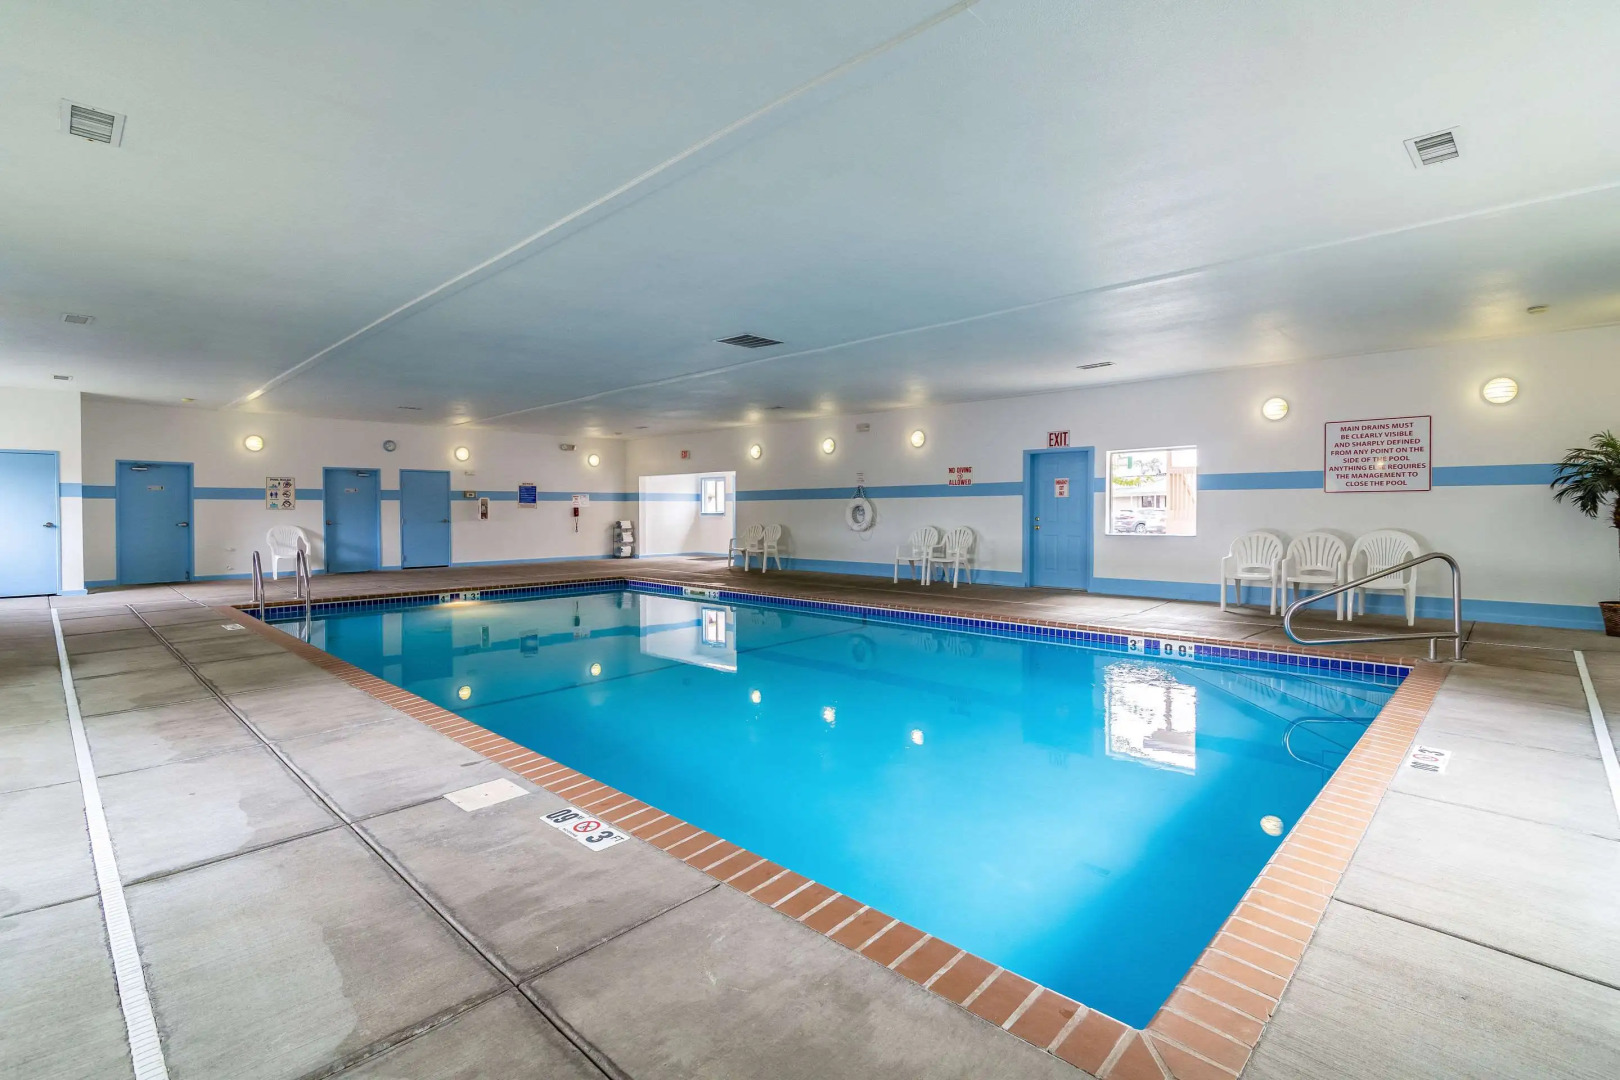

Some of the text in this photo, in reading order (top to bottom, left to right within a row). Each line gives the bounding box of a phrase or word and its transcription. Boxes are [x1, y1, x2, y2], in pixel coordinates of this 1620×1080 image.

[1049, 432, 1068, 446] EXIT
[1351, 432, 1383, 440] CLEARLY
[1351, 440, 1385, 448] SHARPLY
[1386, 438, 1421, 446] DEFINED
[957, 466, 972, 474] DIVING
[1387, 462, 1427, 470] REQUIRES
[1351, 471, 1406, 479] MANAGEMENT
[585, 831, 614, 843] 3
